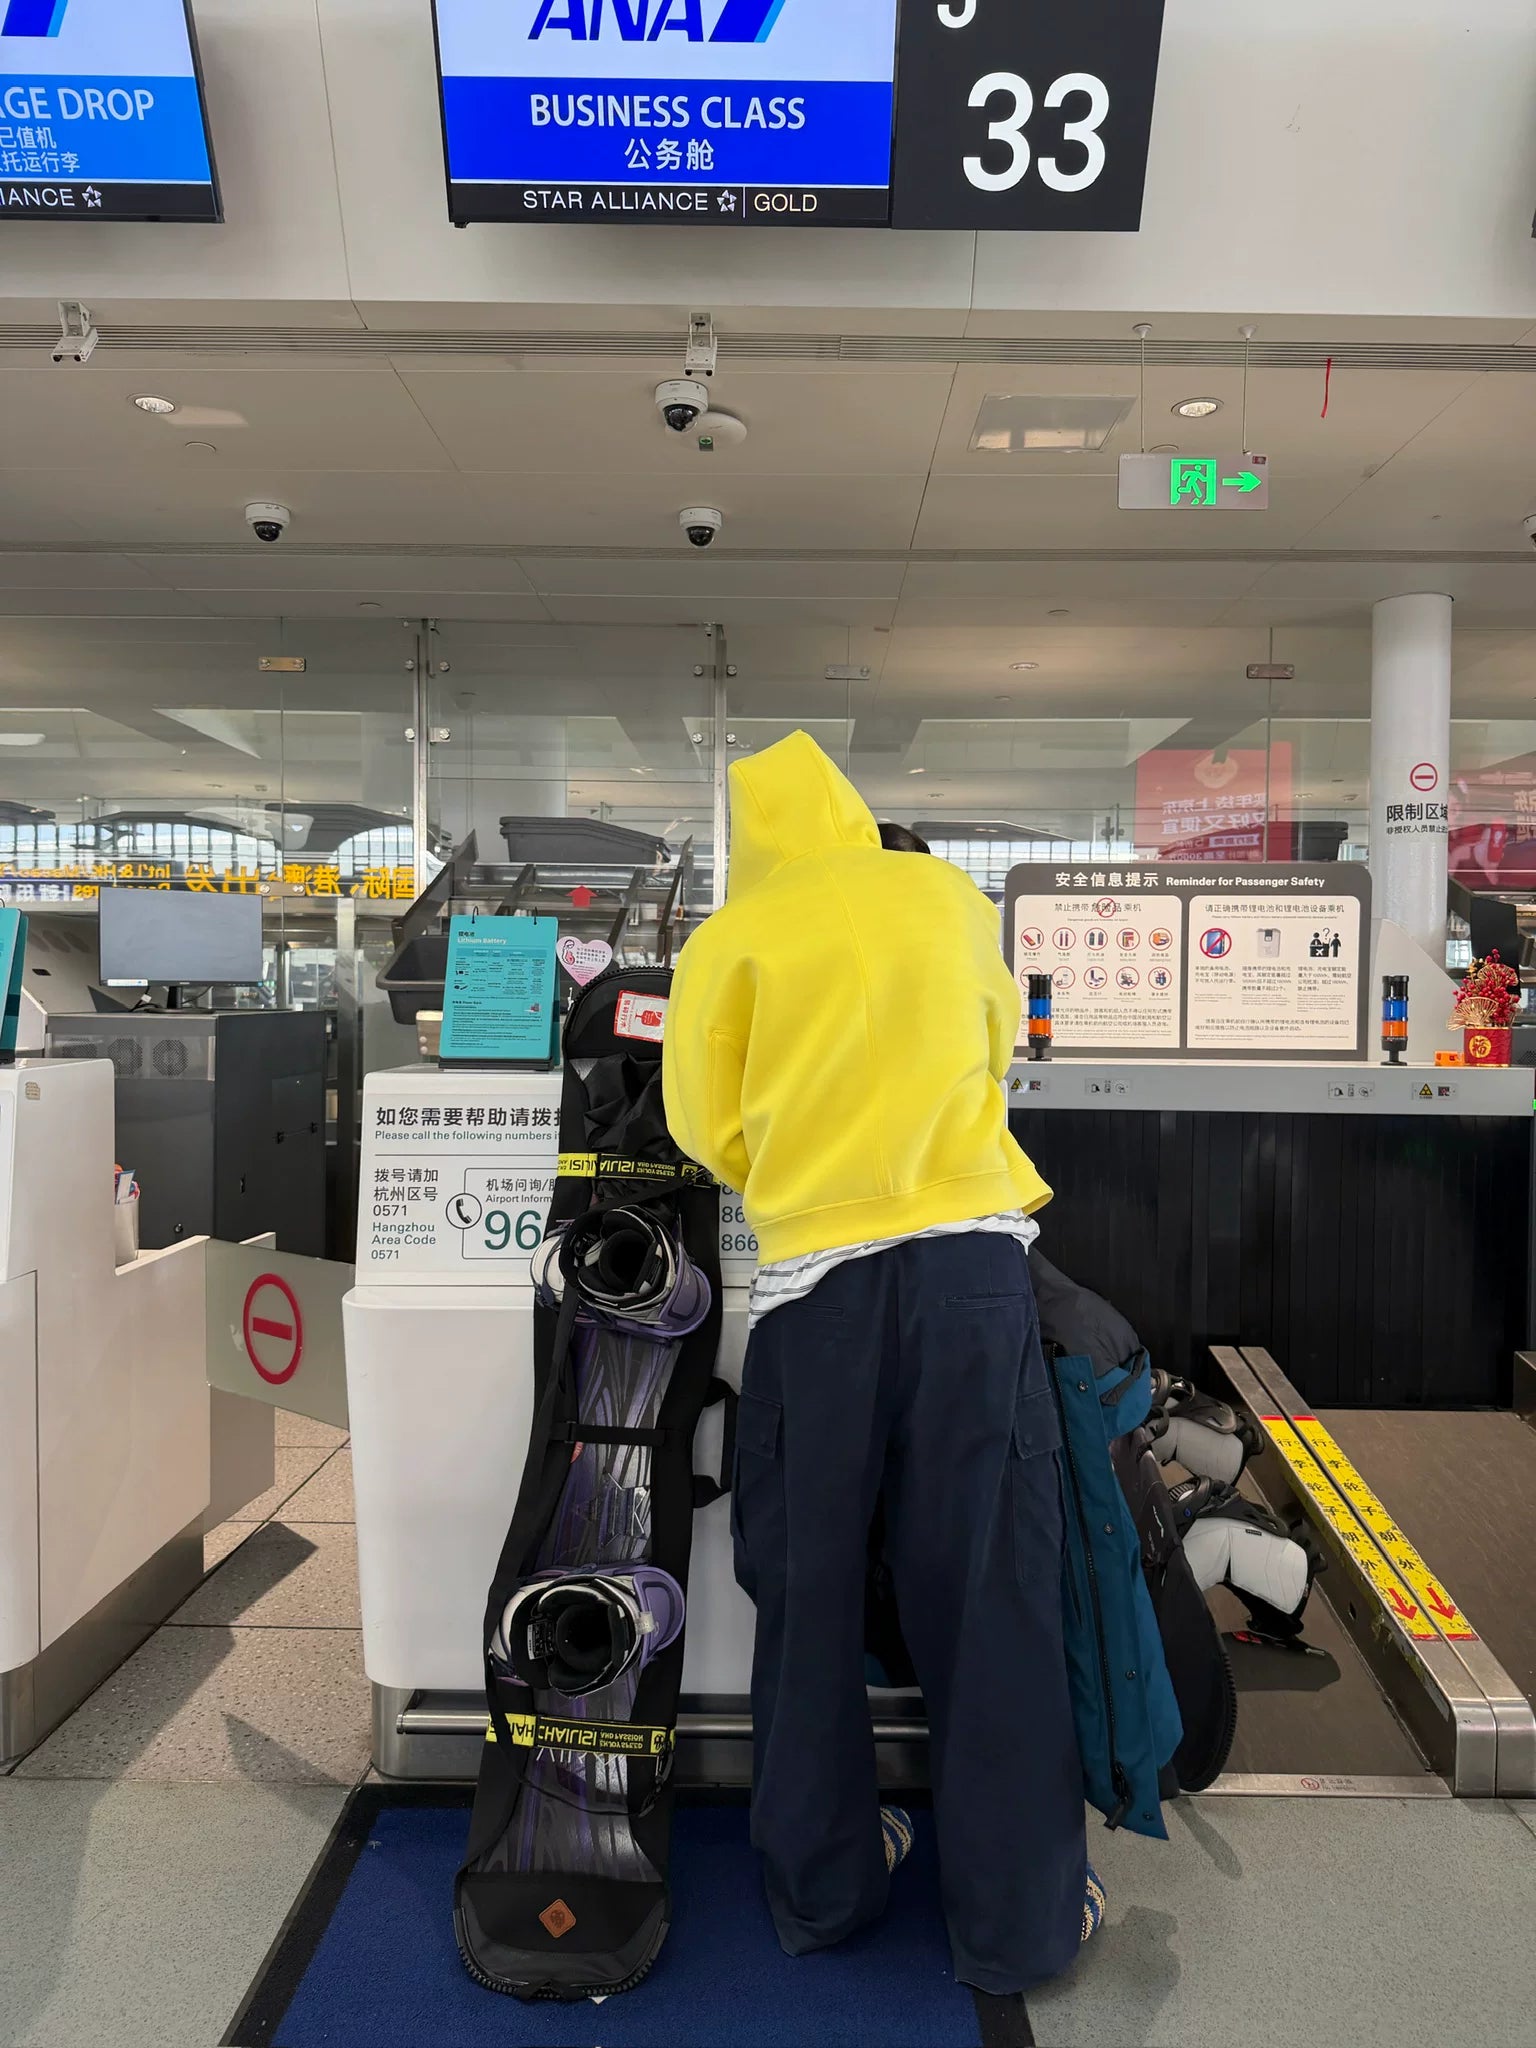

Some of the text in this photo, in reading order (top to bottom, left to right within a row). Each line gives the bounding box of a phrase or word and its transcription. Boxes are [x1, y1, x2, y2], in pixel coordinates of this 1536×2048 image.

[57, 88, 154, 121] DROP
[530, 93, 806, 130] BUSINESS CLASS
[0, 126, 57, 149] 已值机
[963, 72, 1109, 193] 33
[0, 151, 80, 173] 托运行李
[624, 138, 715, 171] 公务舱
[523, 190, 709, 212] STAR ALLIANCE
[753, 192, 818, 213] GOLD
[1055, 872, 1159, 888] 安全信息提示
[1166, 877, 1325, 888] Reminder for Passenger Safety
[375, 1131, 410, 1140] Please
[412, 1130, 430, 1140] call
[433, 1130, 450, 1140] the
[452, 1130, 502, 1142] following
[505, 1130, 552, 1141] numbers
[374, 1168, 439, 1183] 拨号请加
[373, 1186, 438, 1202] 杭州区号
[486, 1194, 520, 1204] Airport
[373, 1204, 408, 1217] 0571
[372, 1222, 435, 1235] Hangzhou
[484, 1210, 542, 1250] 96
[371, 1234, 437, 1245] Area Code
[721, 1234, 759, 1251] 866
[371, 1249, 400, 1260] 0571
